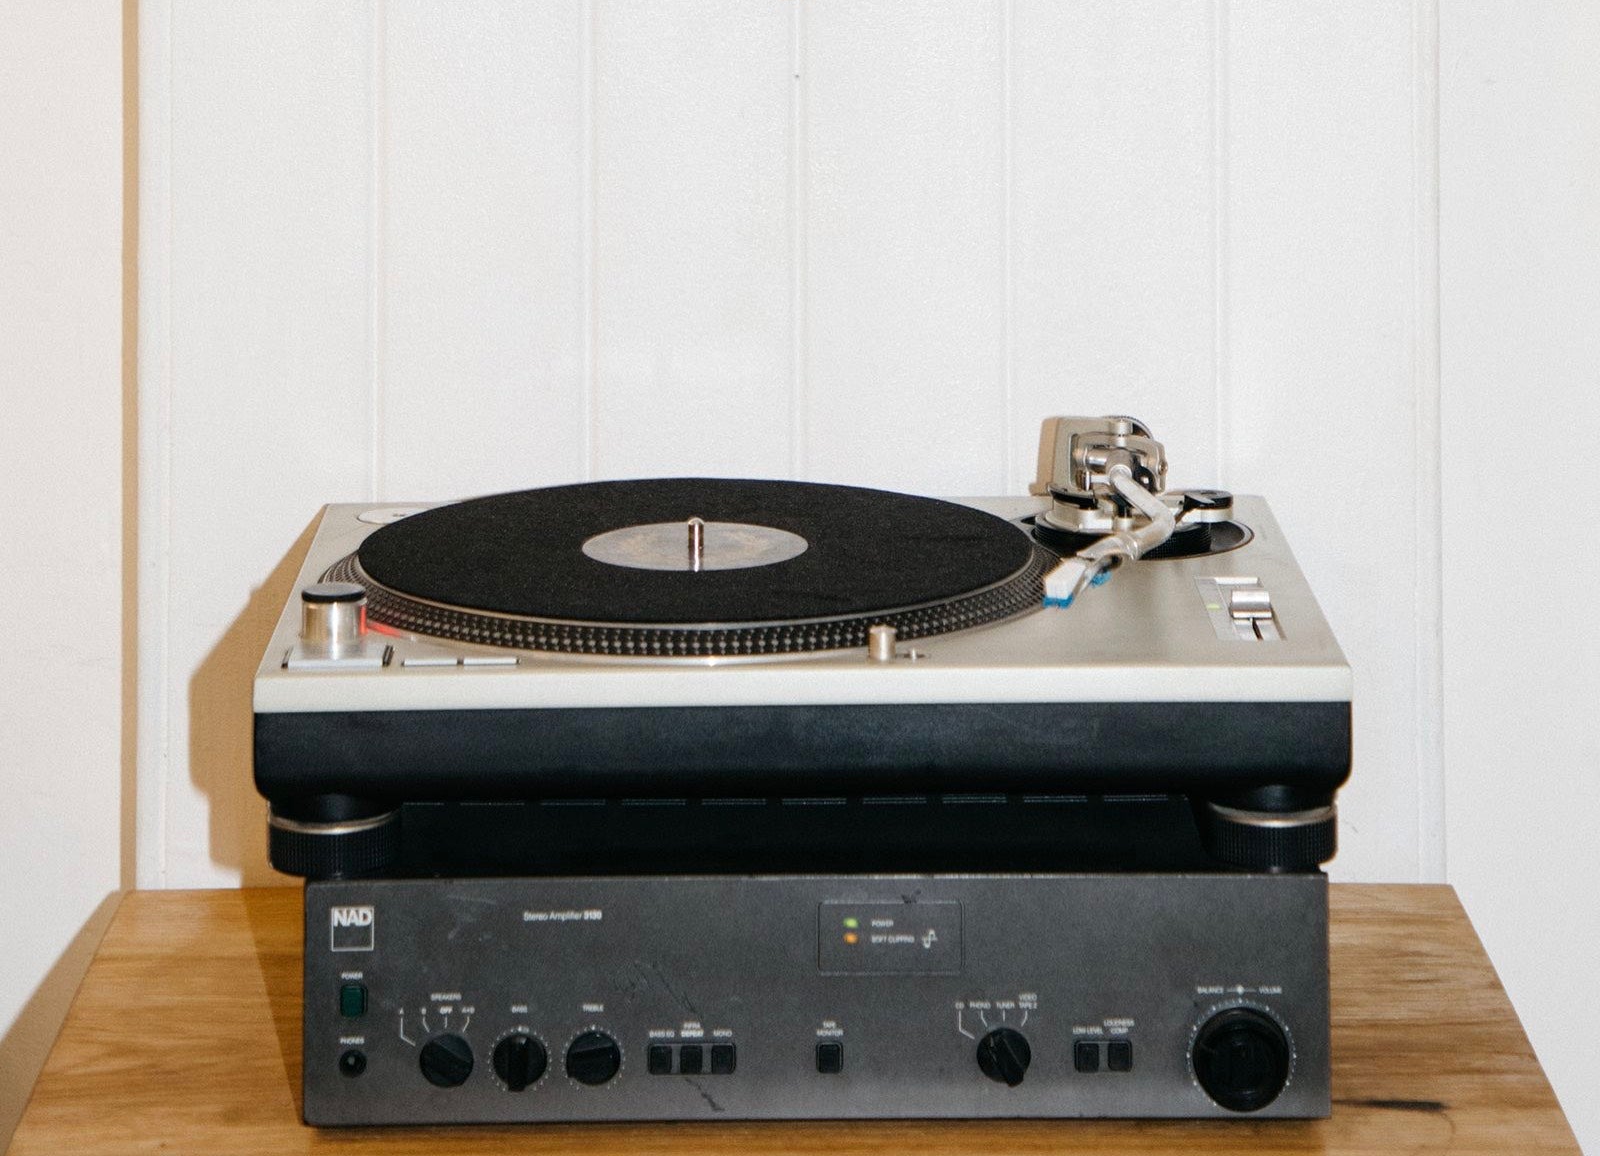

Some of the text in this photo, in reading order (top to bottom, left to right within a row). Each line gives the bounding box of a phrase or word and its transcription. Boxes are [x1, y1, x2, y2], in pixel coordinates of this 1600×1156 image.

[333, 906, 372, 927] NAD
[523, 910, 548, 921] Stereo
[549, 910, 582, 922] Amplifier
[871, 919, 894, 927] POWER
